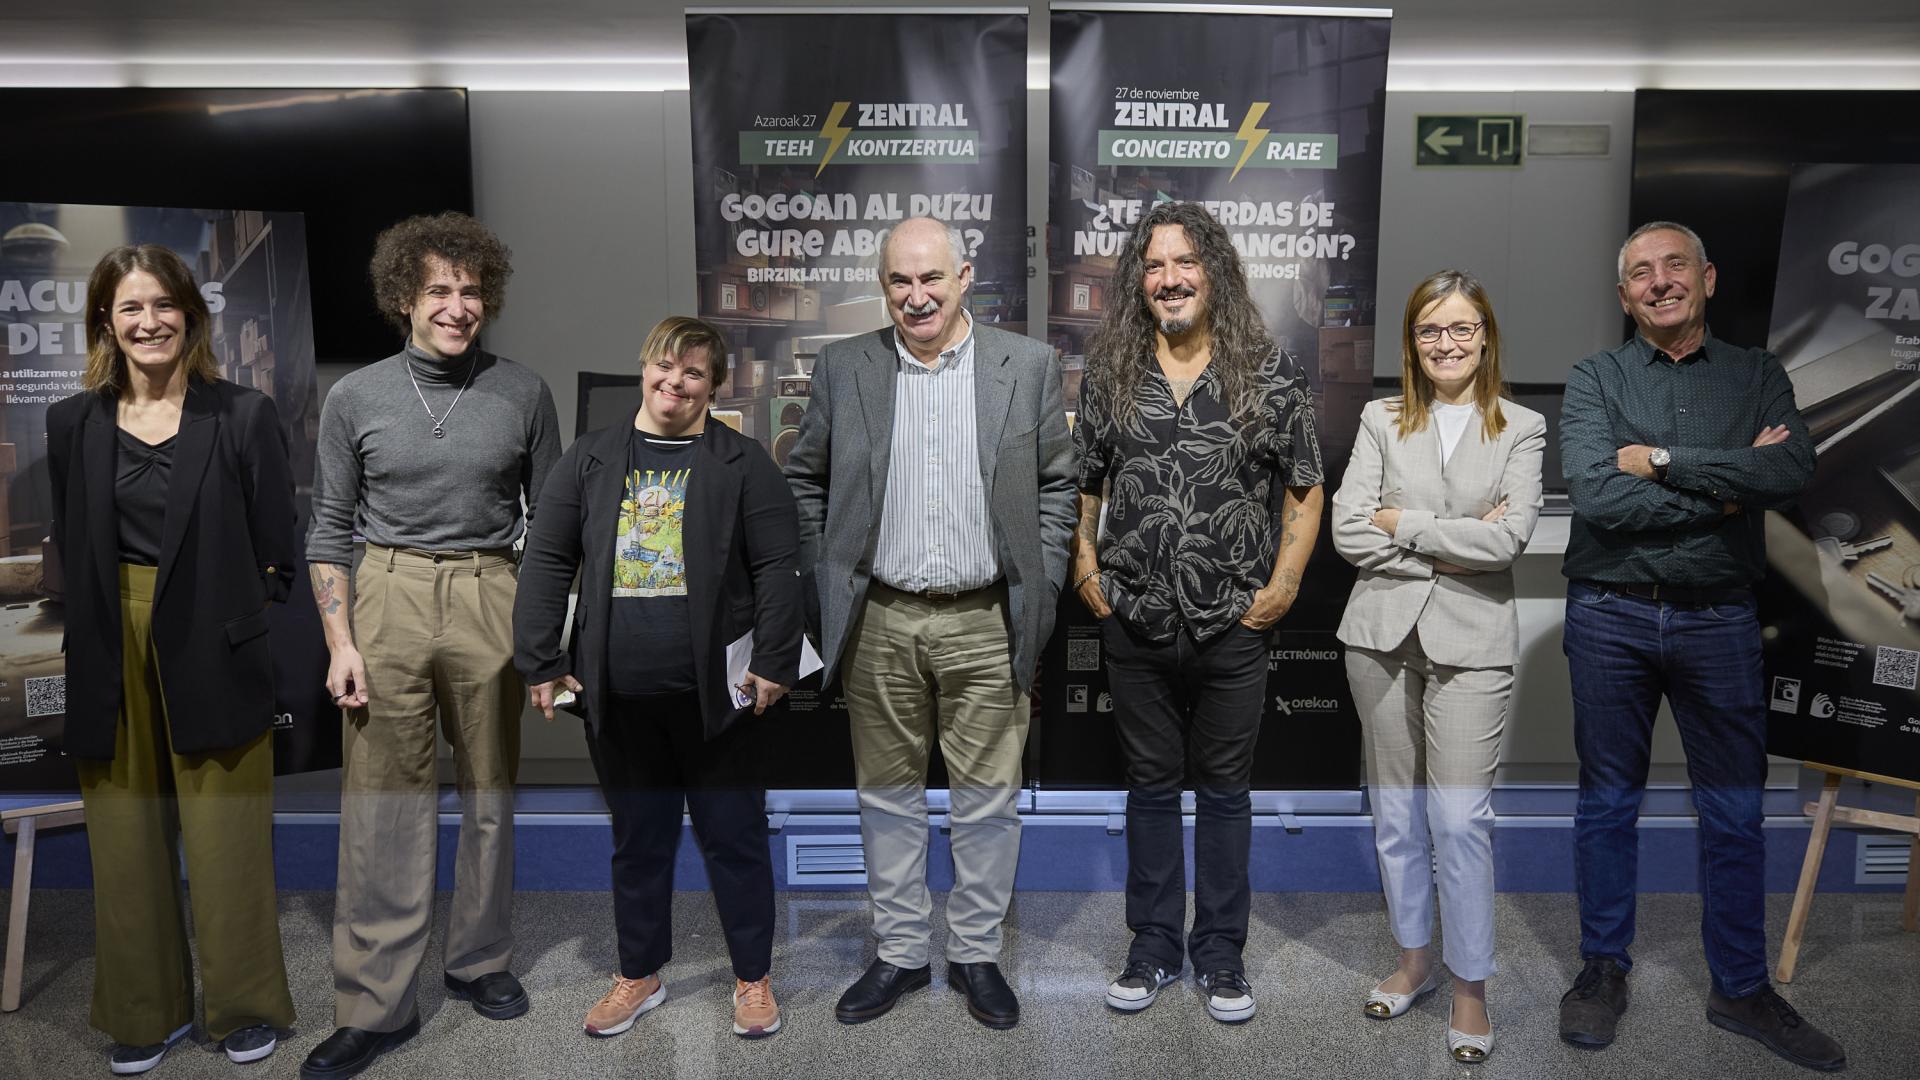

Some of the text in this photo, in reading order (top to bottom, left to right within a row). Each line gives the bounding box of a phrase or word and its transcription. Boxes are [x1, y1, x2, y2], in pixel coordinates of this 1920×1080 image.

[1115, 87, 1200, 100] 27 de noviembre
[754, 114, 817, 127] Azaroak 27
[858, 103, 968, 127] ZENTRAL
[1114, 102, 1229, 128] ZENTRAL
[765, 139, 975, 156] TEEH KONTZERTUA
[1112, 139, 1323, 161] CONCIERTO RAEE
[863, 193, 903, 220] AL
[1092, 199, 1143, 231] ¿TE
[1299, 202, 1335, 227] DE
[1231, 227, 1356, 261] ANCIÓN?
[1828, 241, 1920, 278] GOG
[1865, 286, 1920, 321] ZA
[8, 323, 63, 355] DE
[11, 369, 68, 378] utilizarme
[16, 381, 60, 392] segunda
[6, 394, 46, 404] llévame
[1270, 649, 1338, 660] LECTRÓNICO
[1291, 696, 1338, 709] orekan
